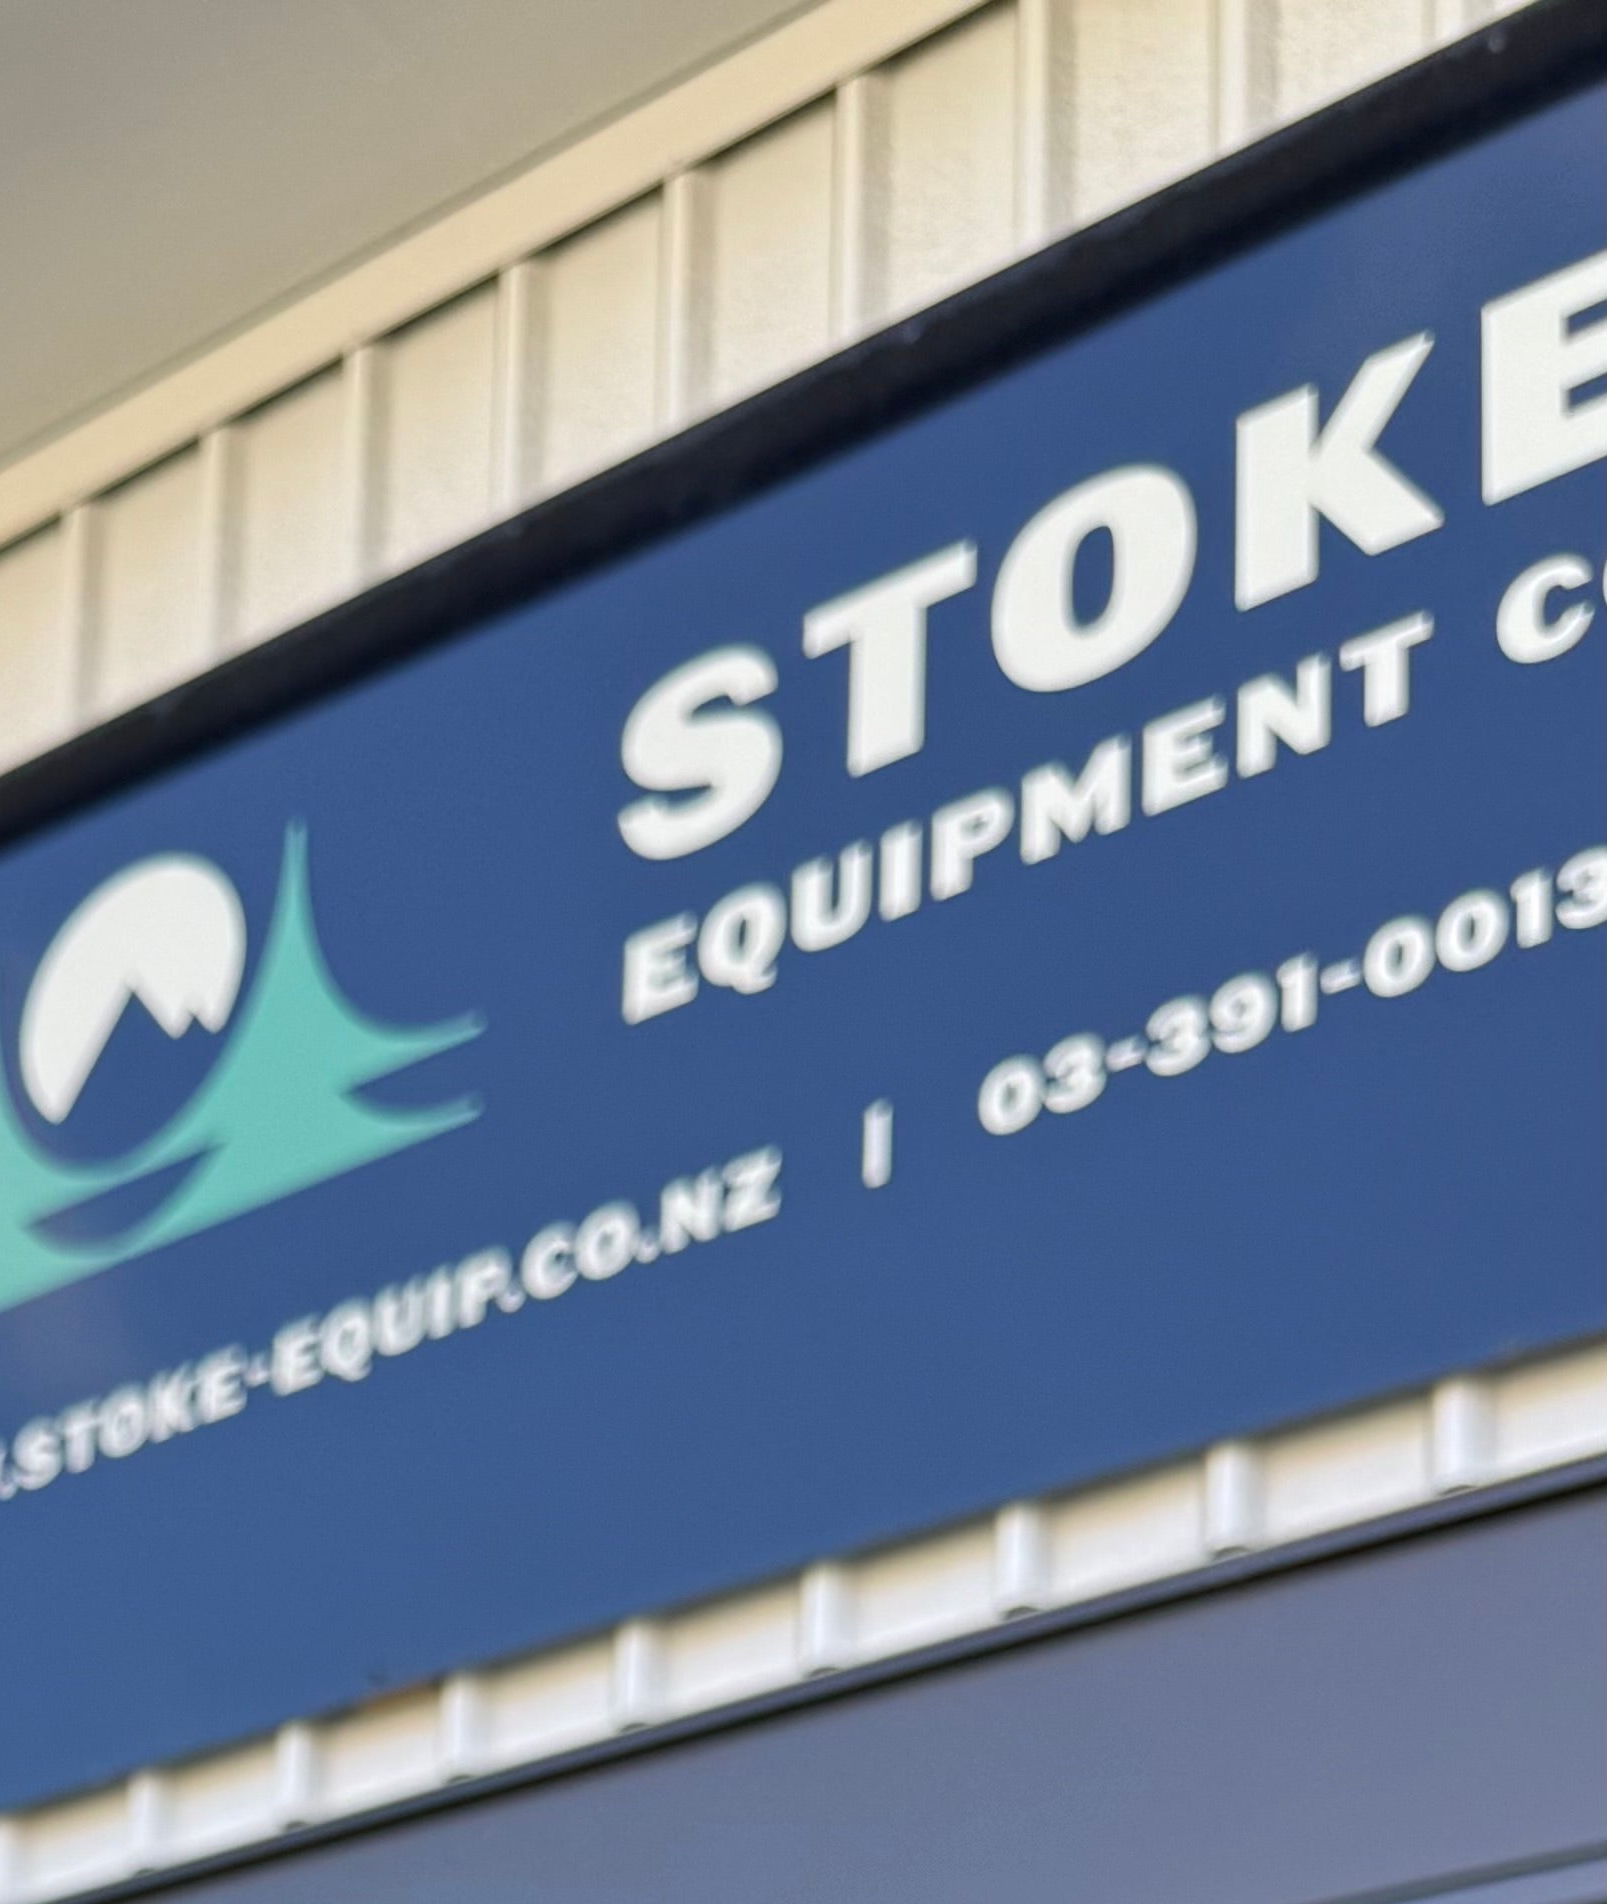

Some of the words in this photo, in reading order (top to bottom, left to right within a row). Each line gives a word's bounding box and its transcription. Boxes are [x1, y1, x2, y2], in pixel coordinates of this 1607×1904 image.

[615, 247, 1607, 861] STOKE
[620, 610, 1435, 1026] EQUIPMENT
[1495, 553, 1607, 666] C
[977, 845, 1607, 1136] 03-391-0013
